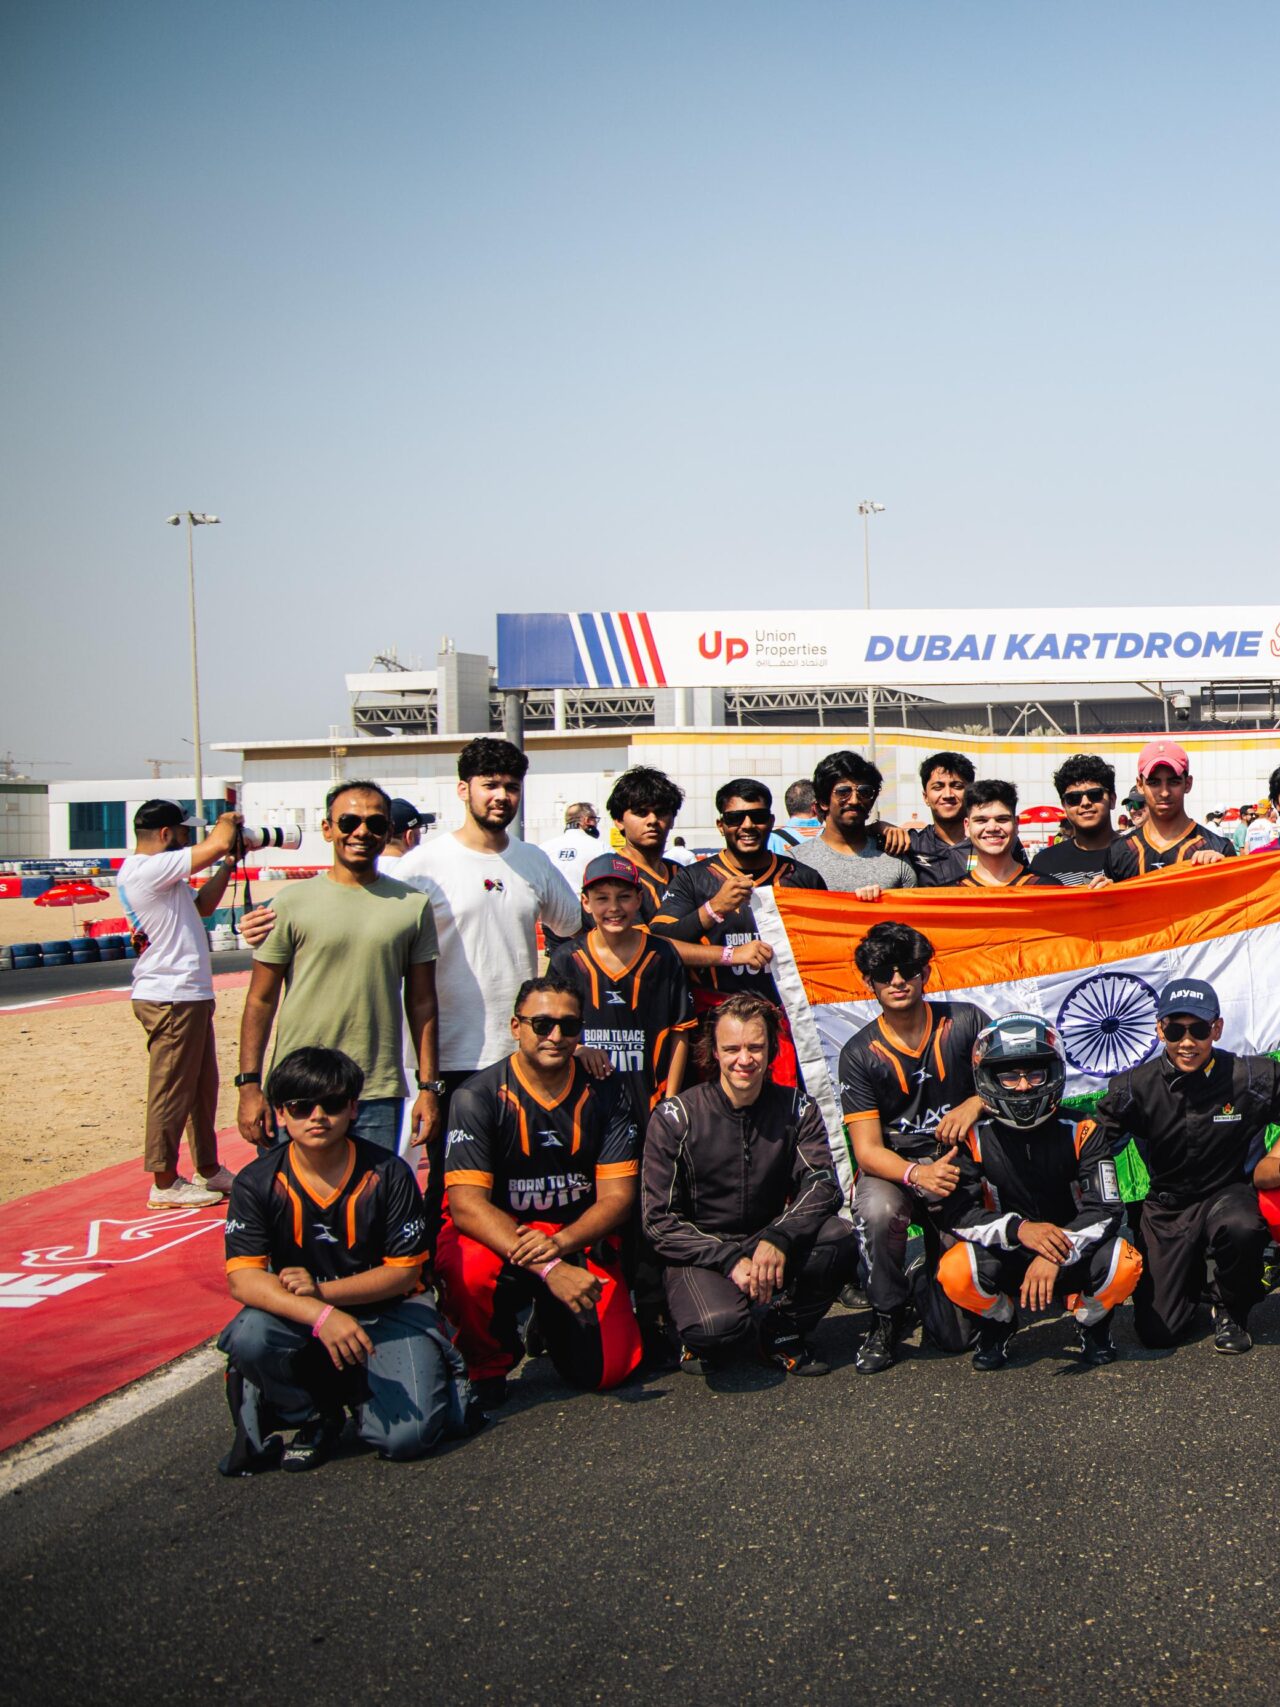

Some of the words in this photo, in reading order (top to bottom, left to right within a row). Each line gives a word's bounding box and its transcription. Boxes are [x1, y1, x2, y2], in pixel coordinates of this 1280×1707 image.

[755, 630, 796, 642] Union
[755, 643, 828, 658] Properties
[864, 634, 996, 662] DUBAI
[1003, 631, 1263, 660] KARTDROME
[1169, 988, 1204, 1001] Aayan
[584, 1029, 610, 1042] BORN
[622, 1030, 645, 1042] RACE
[509, 1178, 545, 1192] BORN
[547, 1175, 566, 1190] TO
